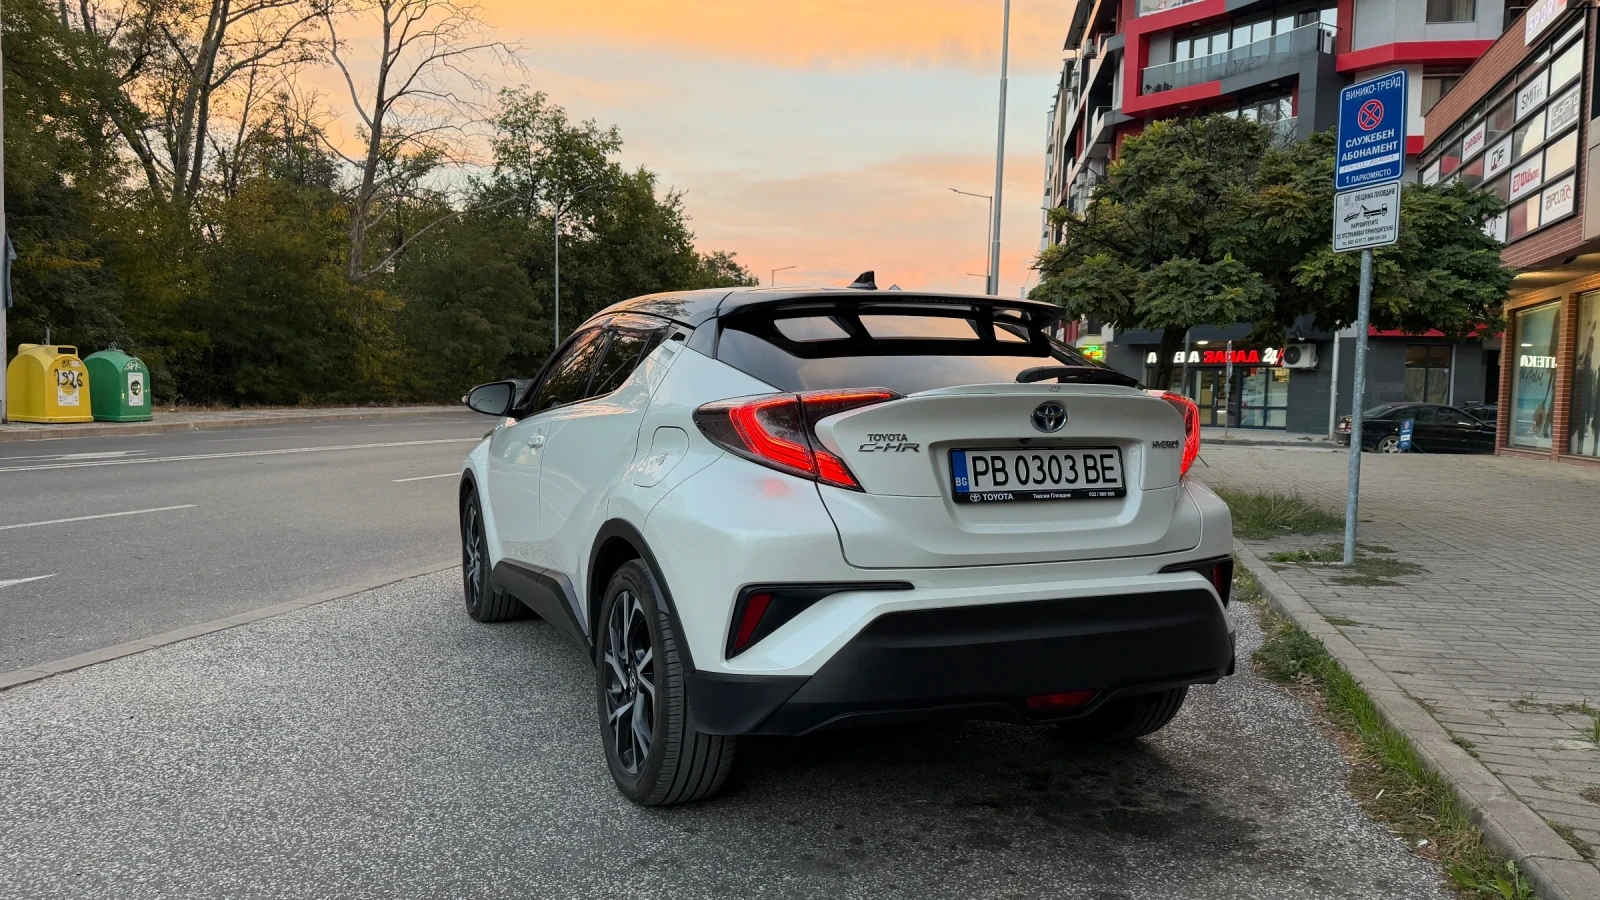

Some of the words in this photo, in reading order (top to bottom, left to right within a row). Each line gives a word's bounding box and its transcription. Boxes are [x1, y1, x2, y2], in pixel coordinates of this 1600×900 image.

[1346, 77, 1401, 101] ВИНИКО-ТРЕЙД
[1521, 80, 1543, 110] SMITH
[1552, 93, 1580, 120] GoPro
[1345, 128, 1395, 148] СЛУЖЕБЕН
[1341, 140, 1399, 162] АБОНАМЕНТ
[1345, 175, 1350, 184] 1
[1351, 168, 1392, 183] ПАРКОМЯСТО
[1520, 167, 1540, 187] Wilson
[1354, 192, 1374, 201] ОБЩИНА
[1374, 187, 1396, 198] ПЛОВДИВ
[54, 368, 83, 389] 1926
[858, 442, 920, 453] C-HR
[867, 433, 908, 442] TOYOTA
[971, 455, 1009, 487] PB
[1014, 454, 1079, 485] 0303
[1082, 453, 1118, 484] BE
[955, 477, 968, 487] BG
[982, 492, 1014, 501] TOYOTA
